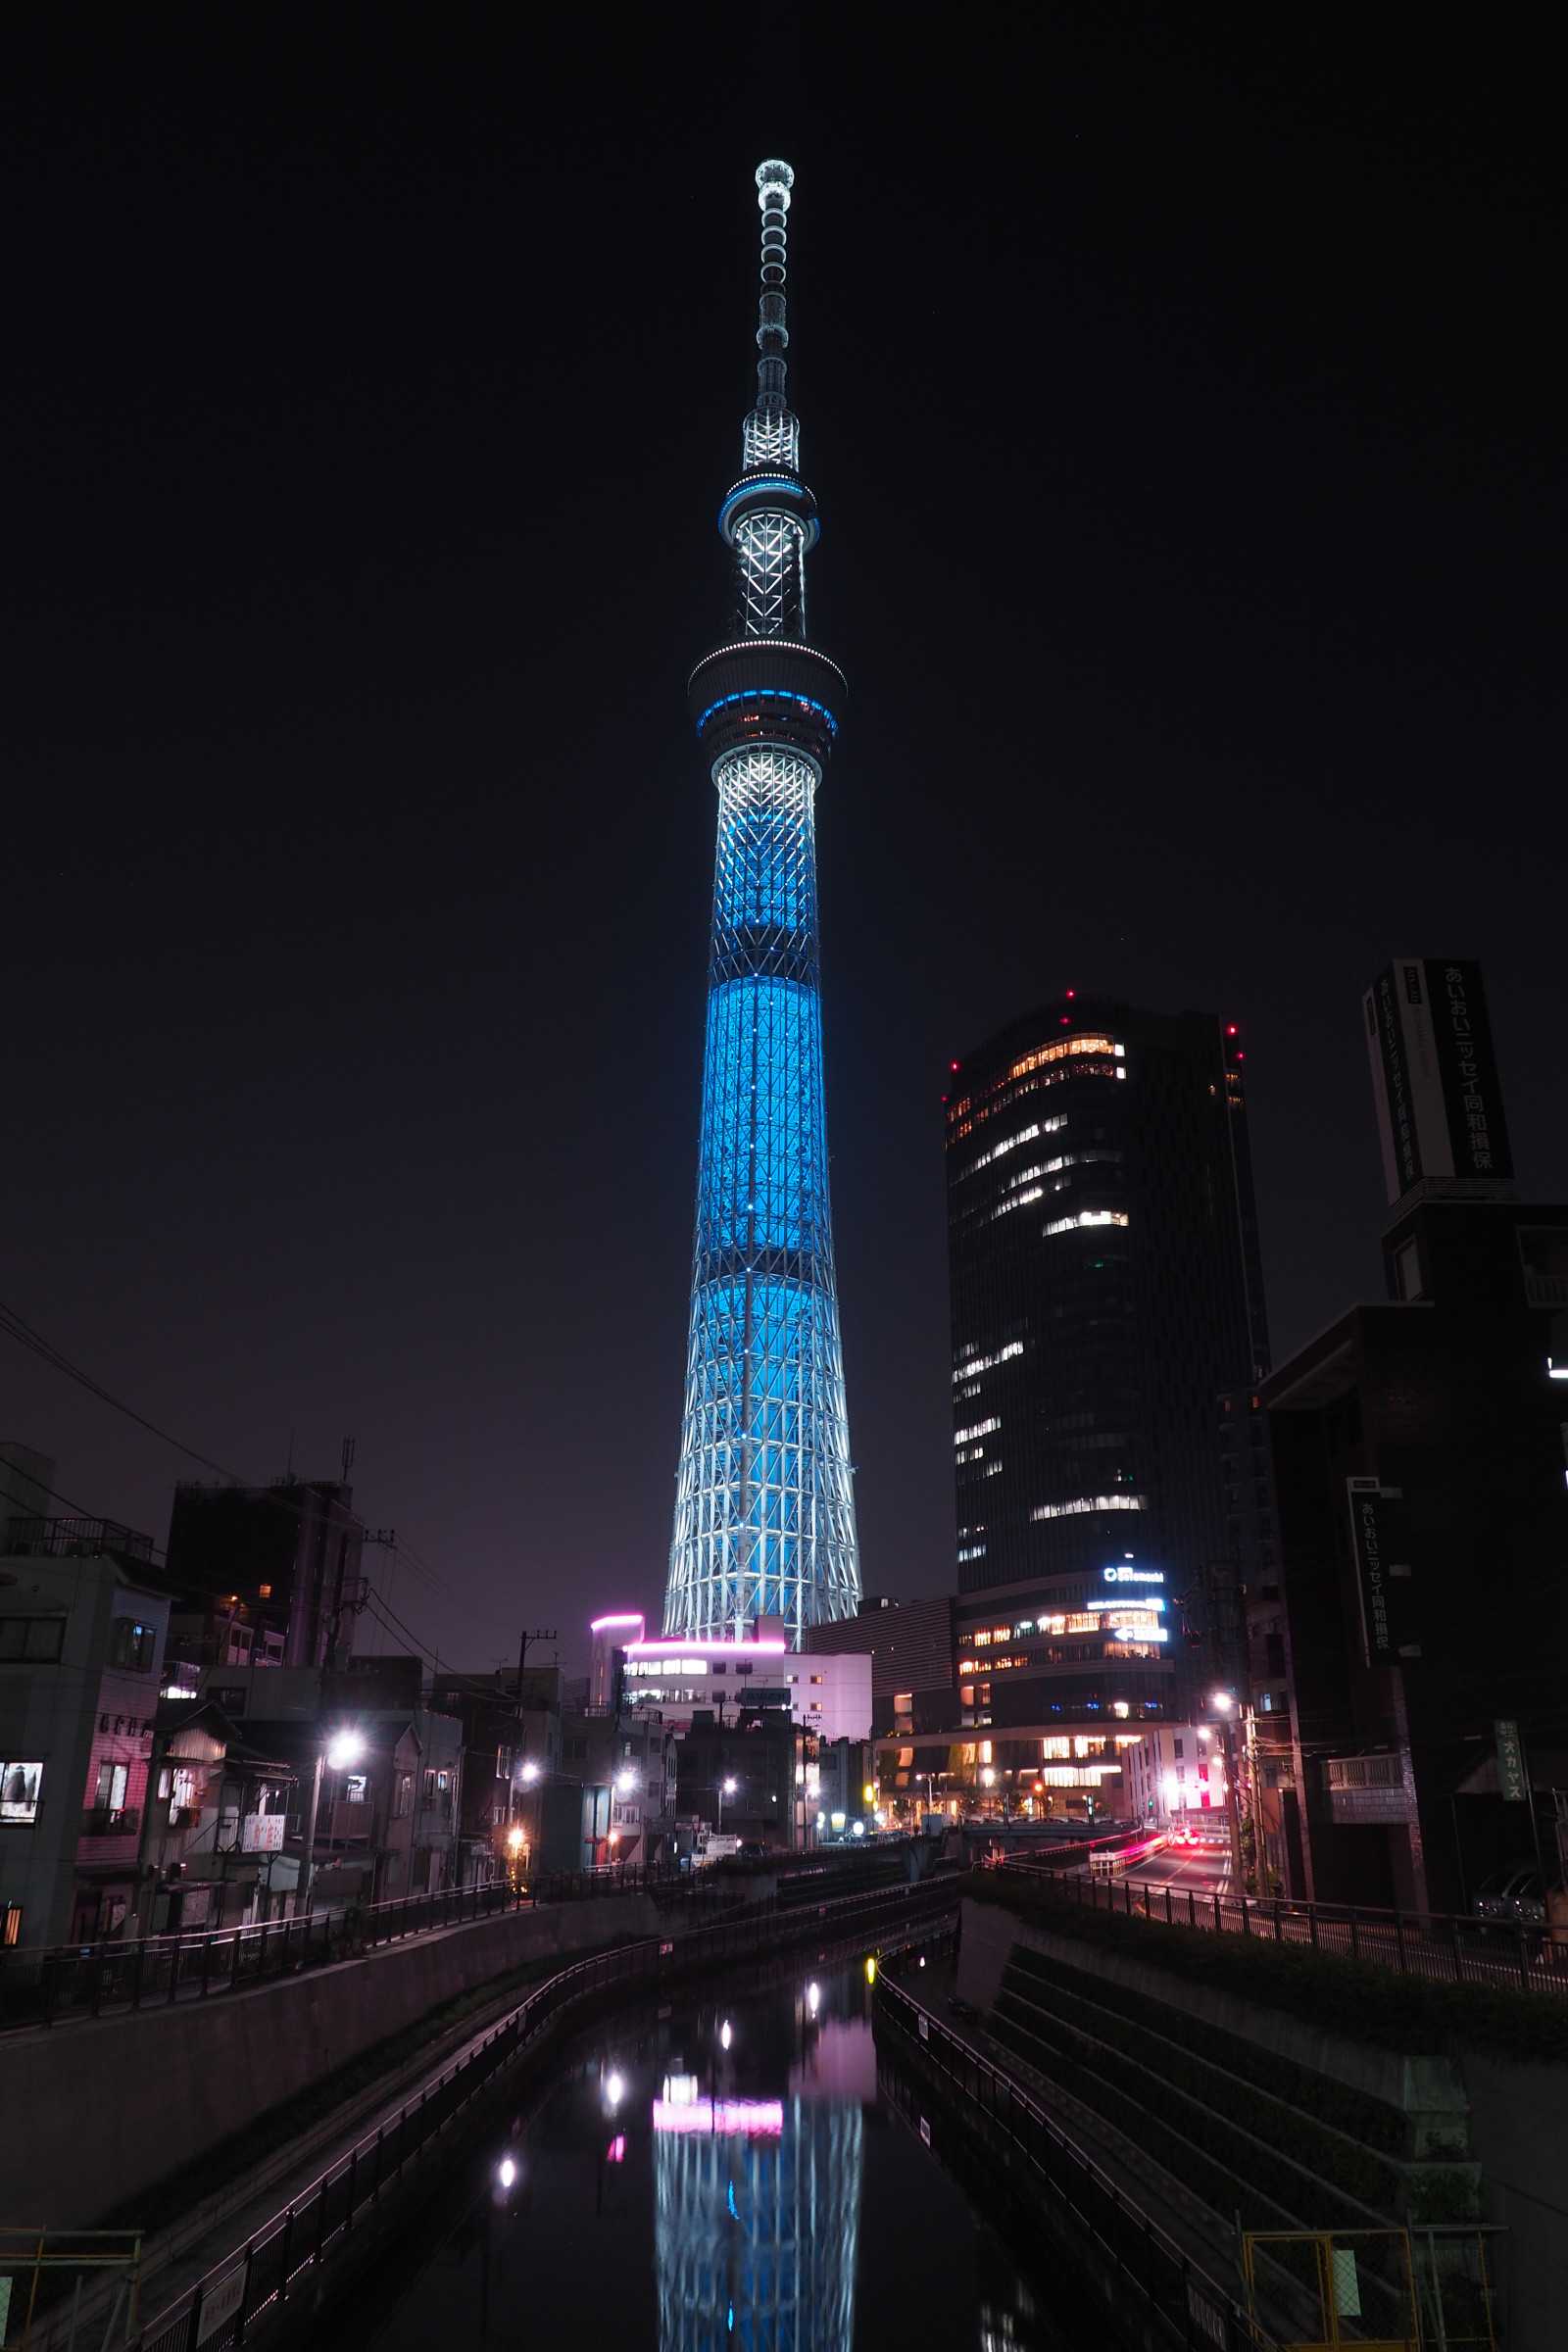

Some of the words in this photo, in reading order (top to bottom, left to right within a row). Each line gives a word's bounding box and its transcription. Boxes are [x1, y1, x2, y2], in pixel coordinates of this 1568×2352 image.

[1445, 966, 1494, 1170] あいおいニッセイ同和損保
[1362, 1503, 1389, 1648] あいおいニッセイ同和損保
